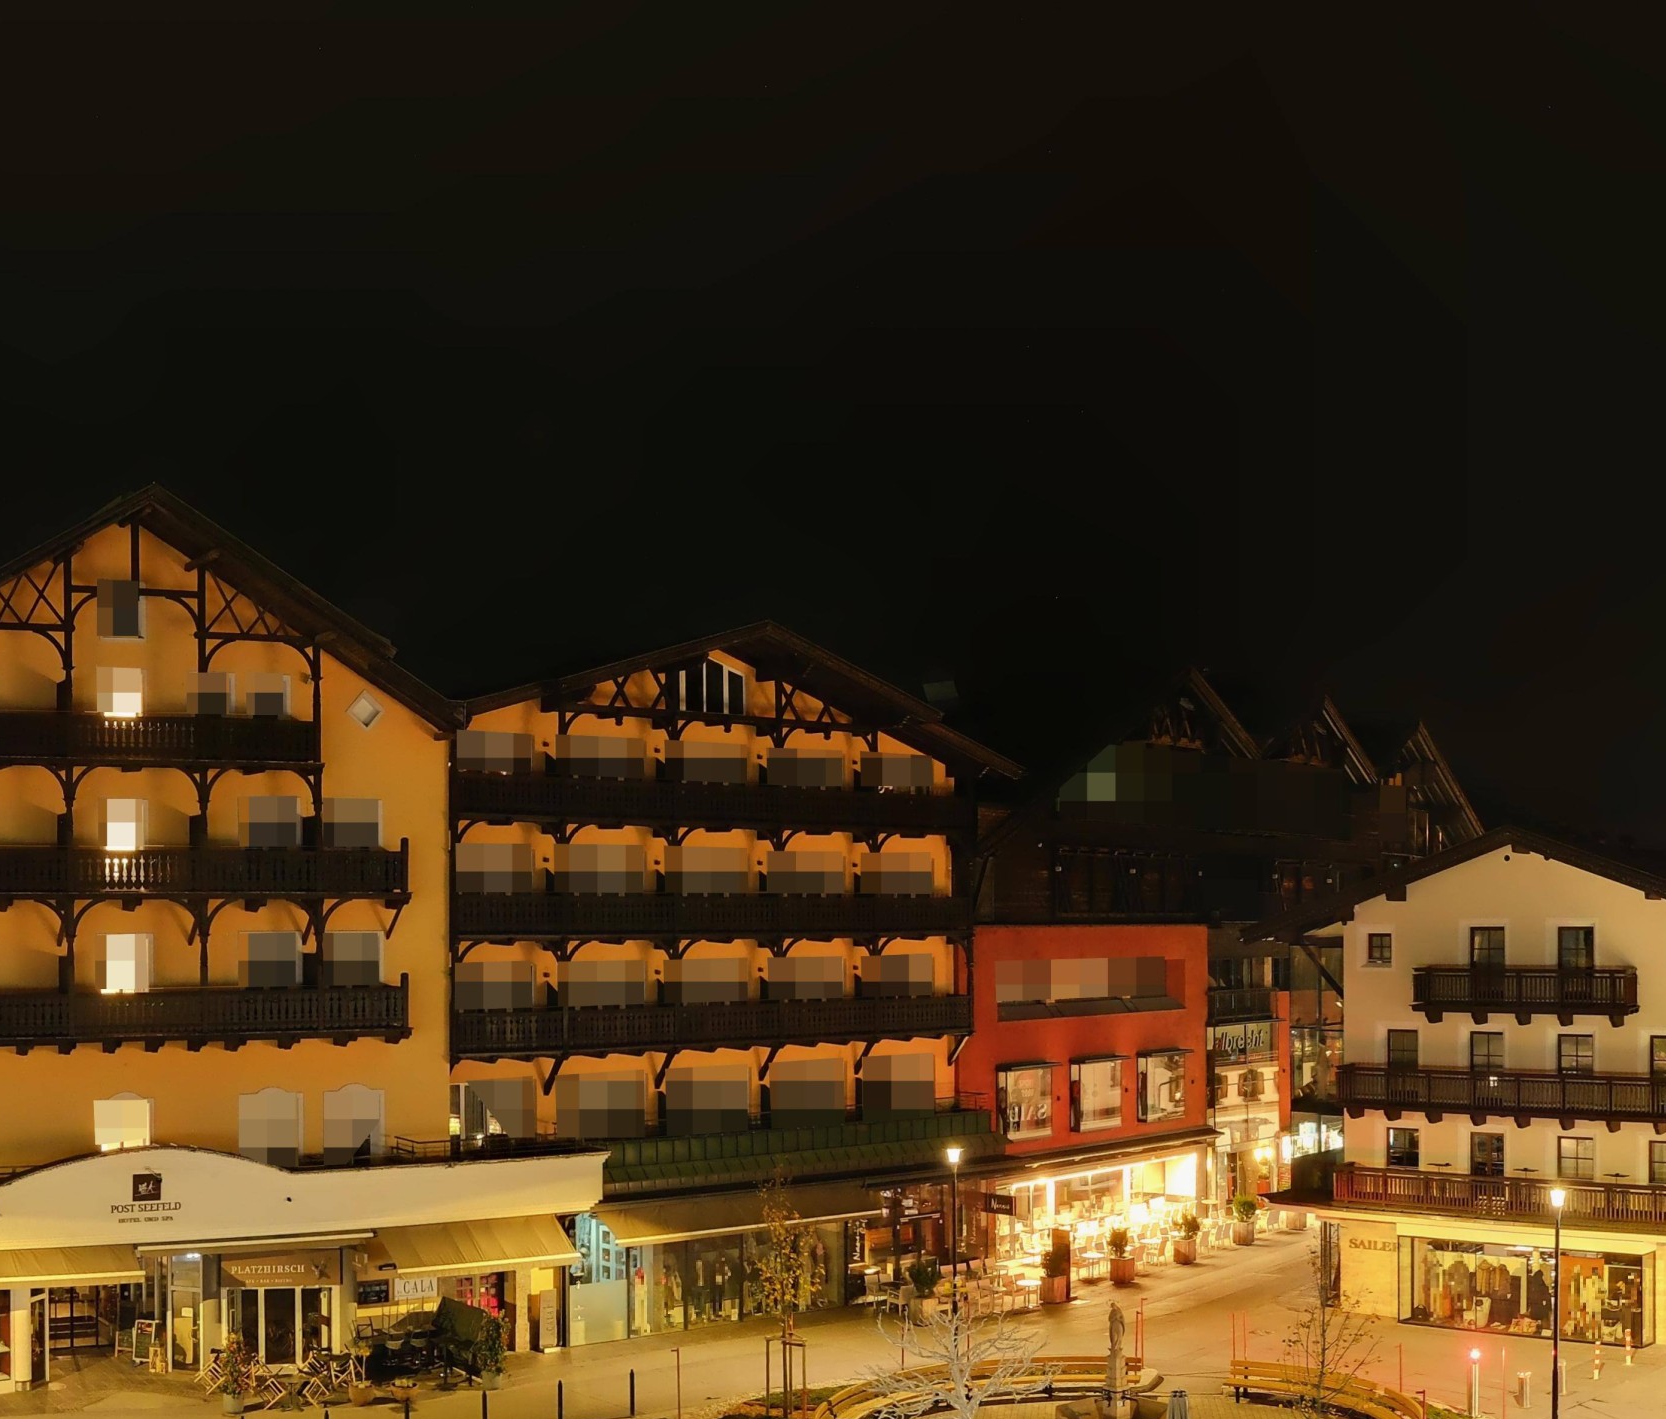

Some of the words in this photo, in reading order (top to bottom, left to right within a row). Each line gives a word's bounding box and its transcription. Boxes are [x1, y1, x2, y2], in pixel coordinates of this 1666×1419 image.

[110, 1204, 136, 1214] POST
[137, 1202, 182, 1212] SEEFELD
[231, 1264, 305, 1274] PLATZHIRSCH
[403, 1279, 435, 1294] CALA
